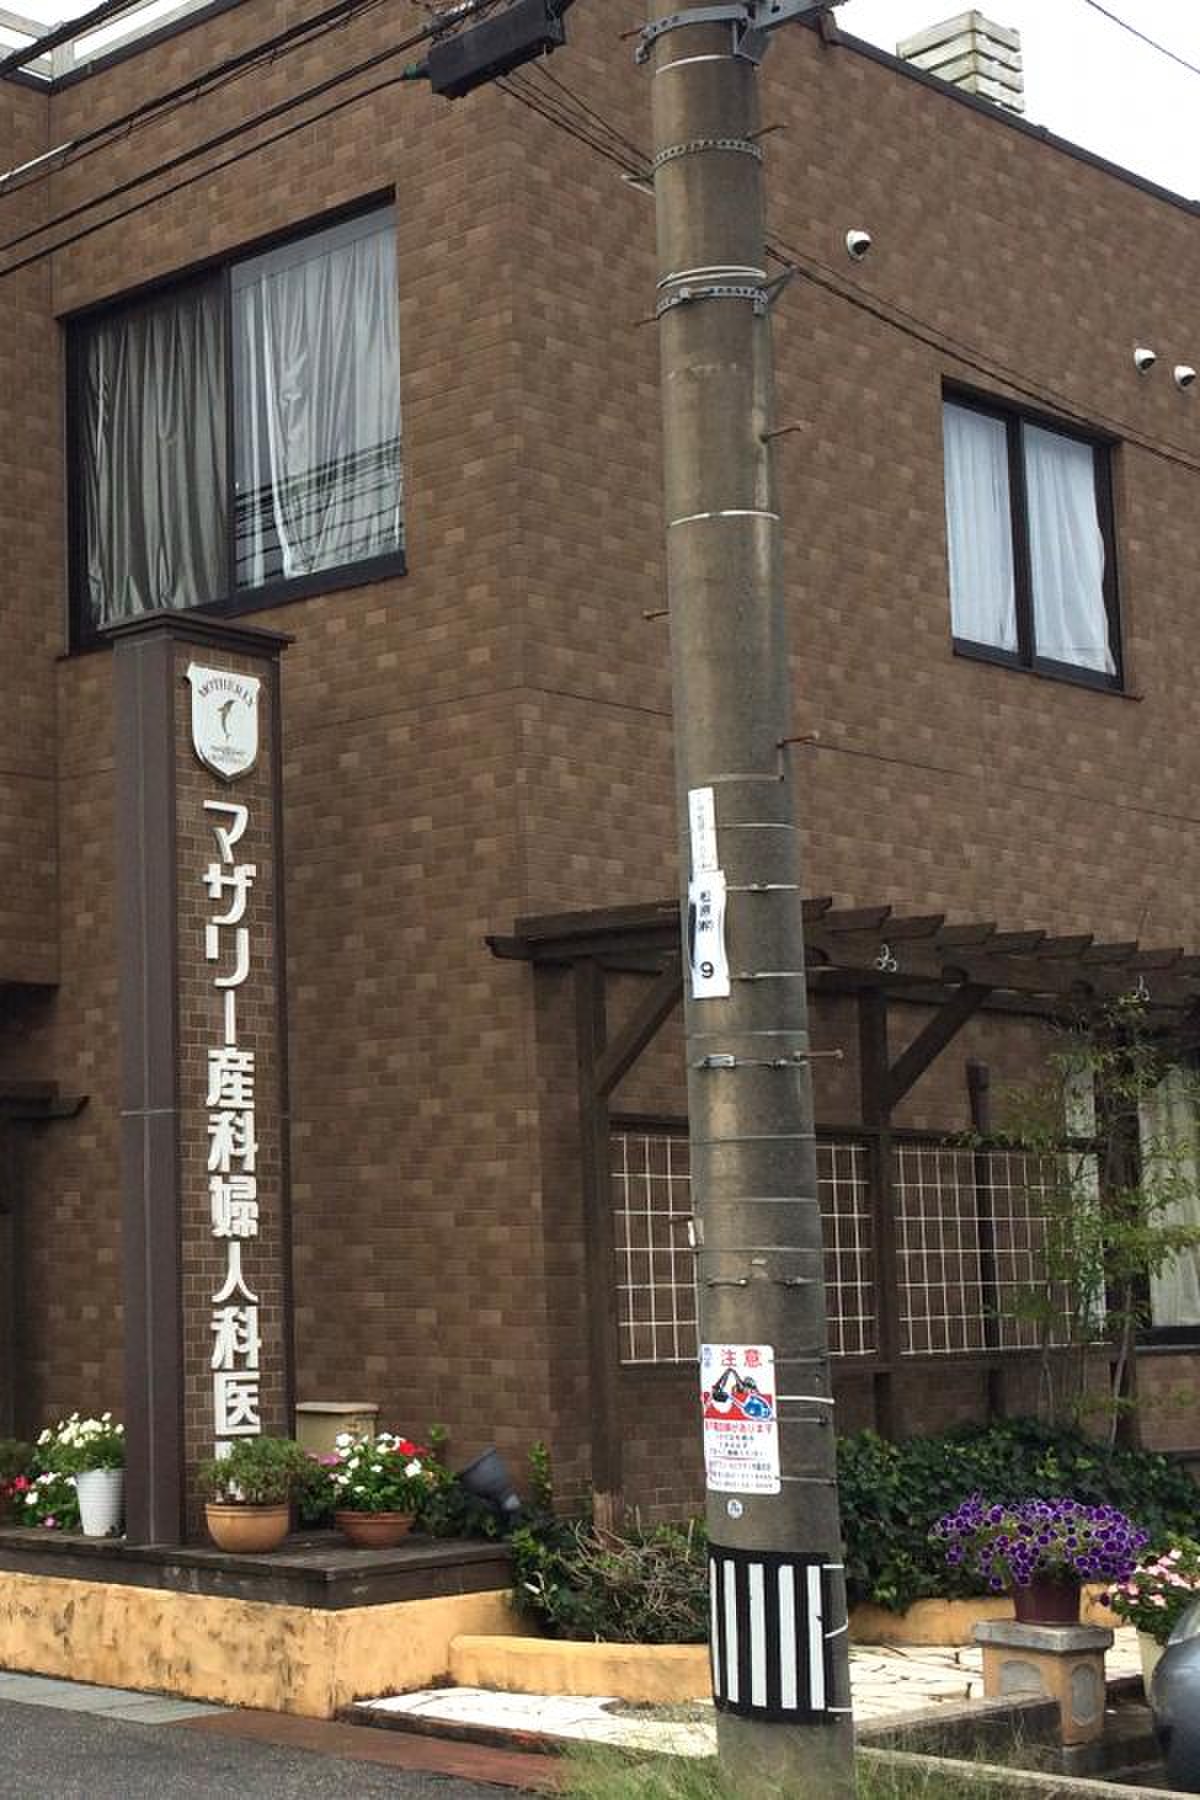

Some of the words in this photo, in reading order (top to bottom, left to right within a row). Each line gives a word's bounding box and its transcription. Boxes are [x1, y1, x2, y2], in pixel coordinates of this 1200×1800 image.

[700, 960, 715, 979] 9
[202, 799, 262, 1464] マザリー産科婦人科医
[720, 1348, 763, 1369] 注意
